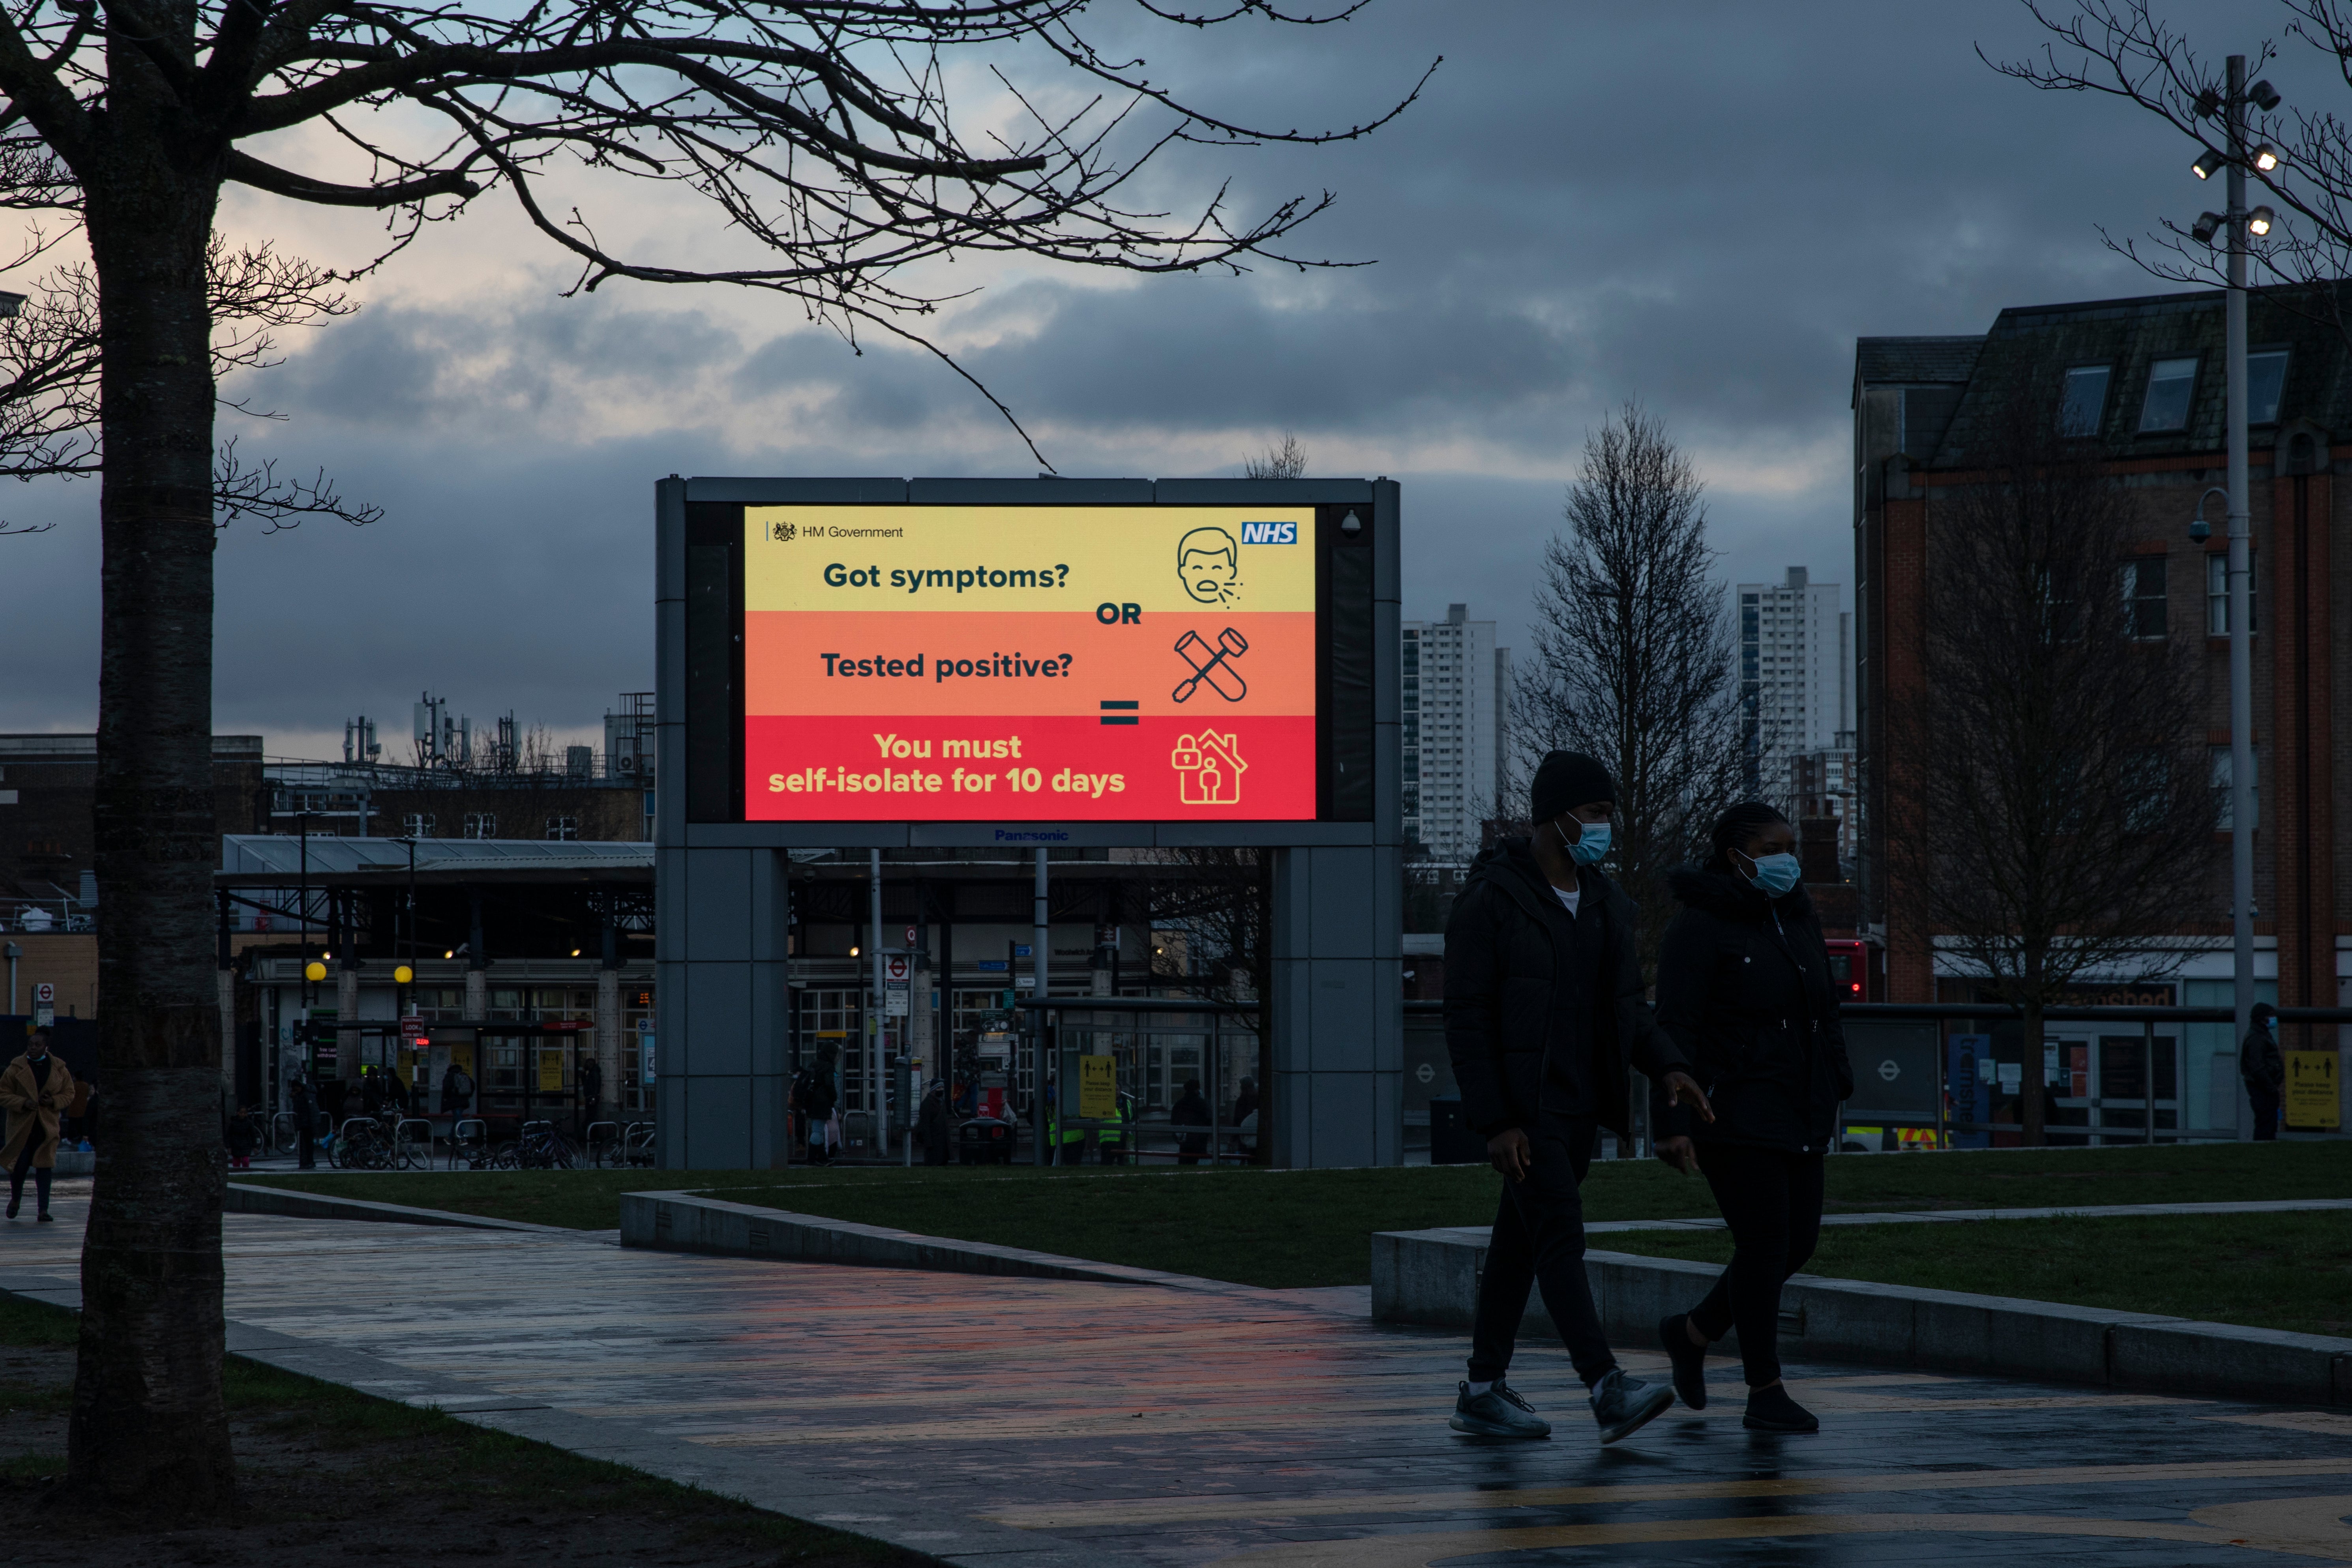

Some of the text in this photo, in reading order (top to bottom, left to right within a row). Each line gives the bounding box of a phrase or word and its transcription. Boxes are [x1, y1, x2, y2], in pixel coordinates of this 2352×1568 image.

[803, 526, 903, 538] HM Government
[1243, 523, 1295, 543] NHS
[824, 563, 1069, 594] Got symptoms?
[1096, 602, 1141, 625] OR
[821, 652, 1073, 683] Tested positive?
[873, 734, 1022, 758] You must
[768, 766, 1125, 798] self-isolate for 10 days
[995, 830, 1068, 841] Panasonic
[908, 929, 915, 940] Q
